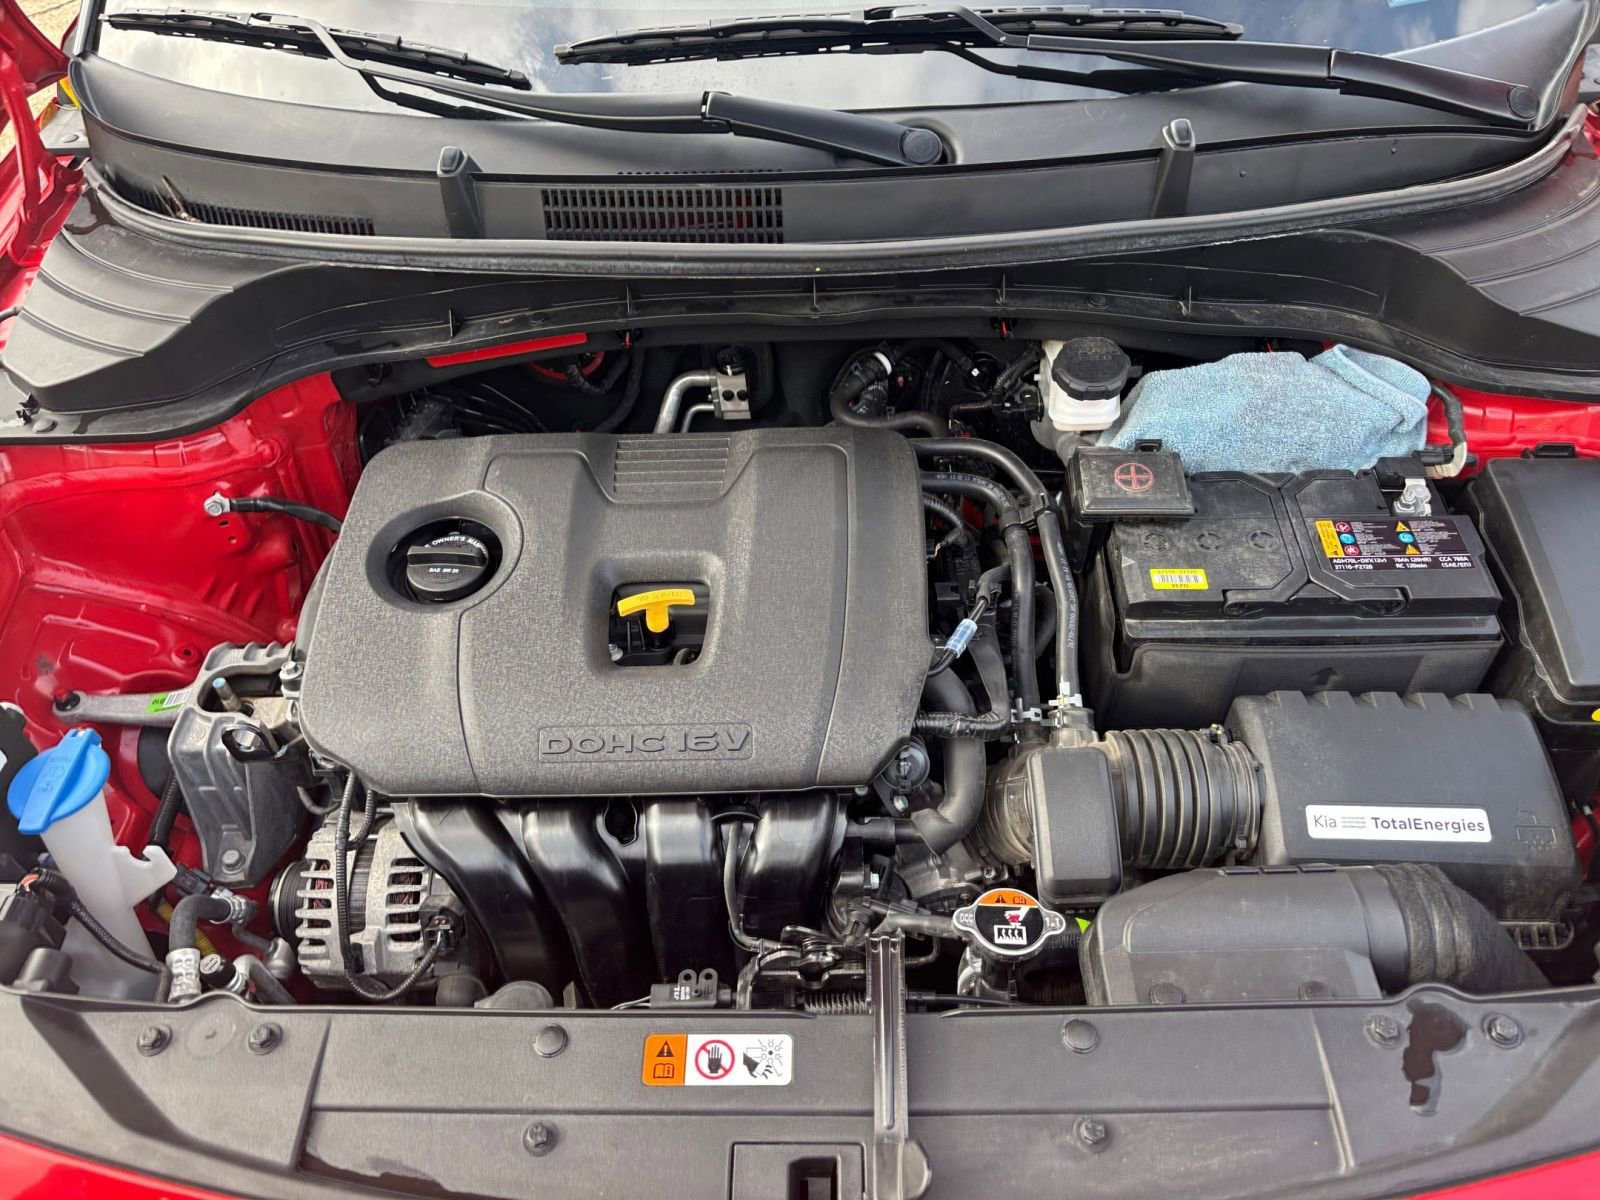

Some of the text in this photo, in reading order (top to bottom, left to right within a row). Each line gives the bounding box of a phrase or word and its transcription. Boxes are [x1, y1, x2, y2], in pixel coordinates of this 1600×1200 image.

[541, 731, 750, 755] DOHC 16V
[1313, 815, 1485, 834] Kia TotalEnergies
